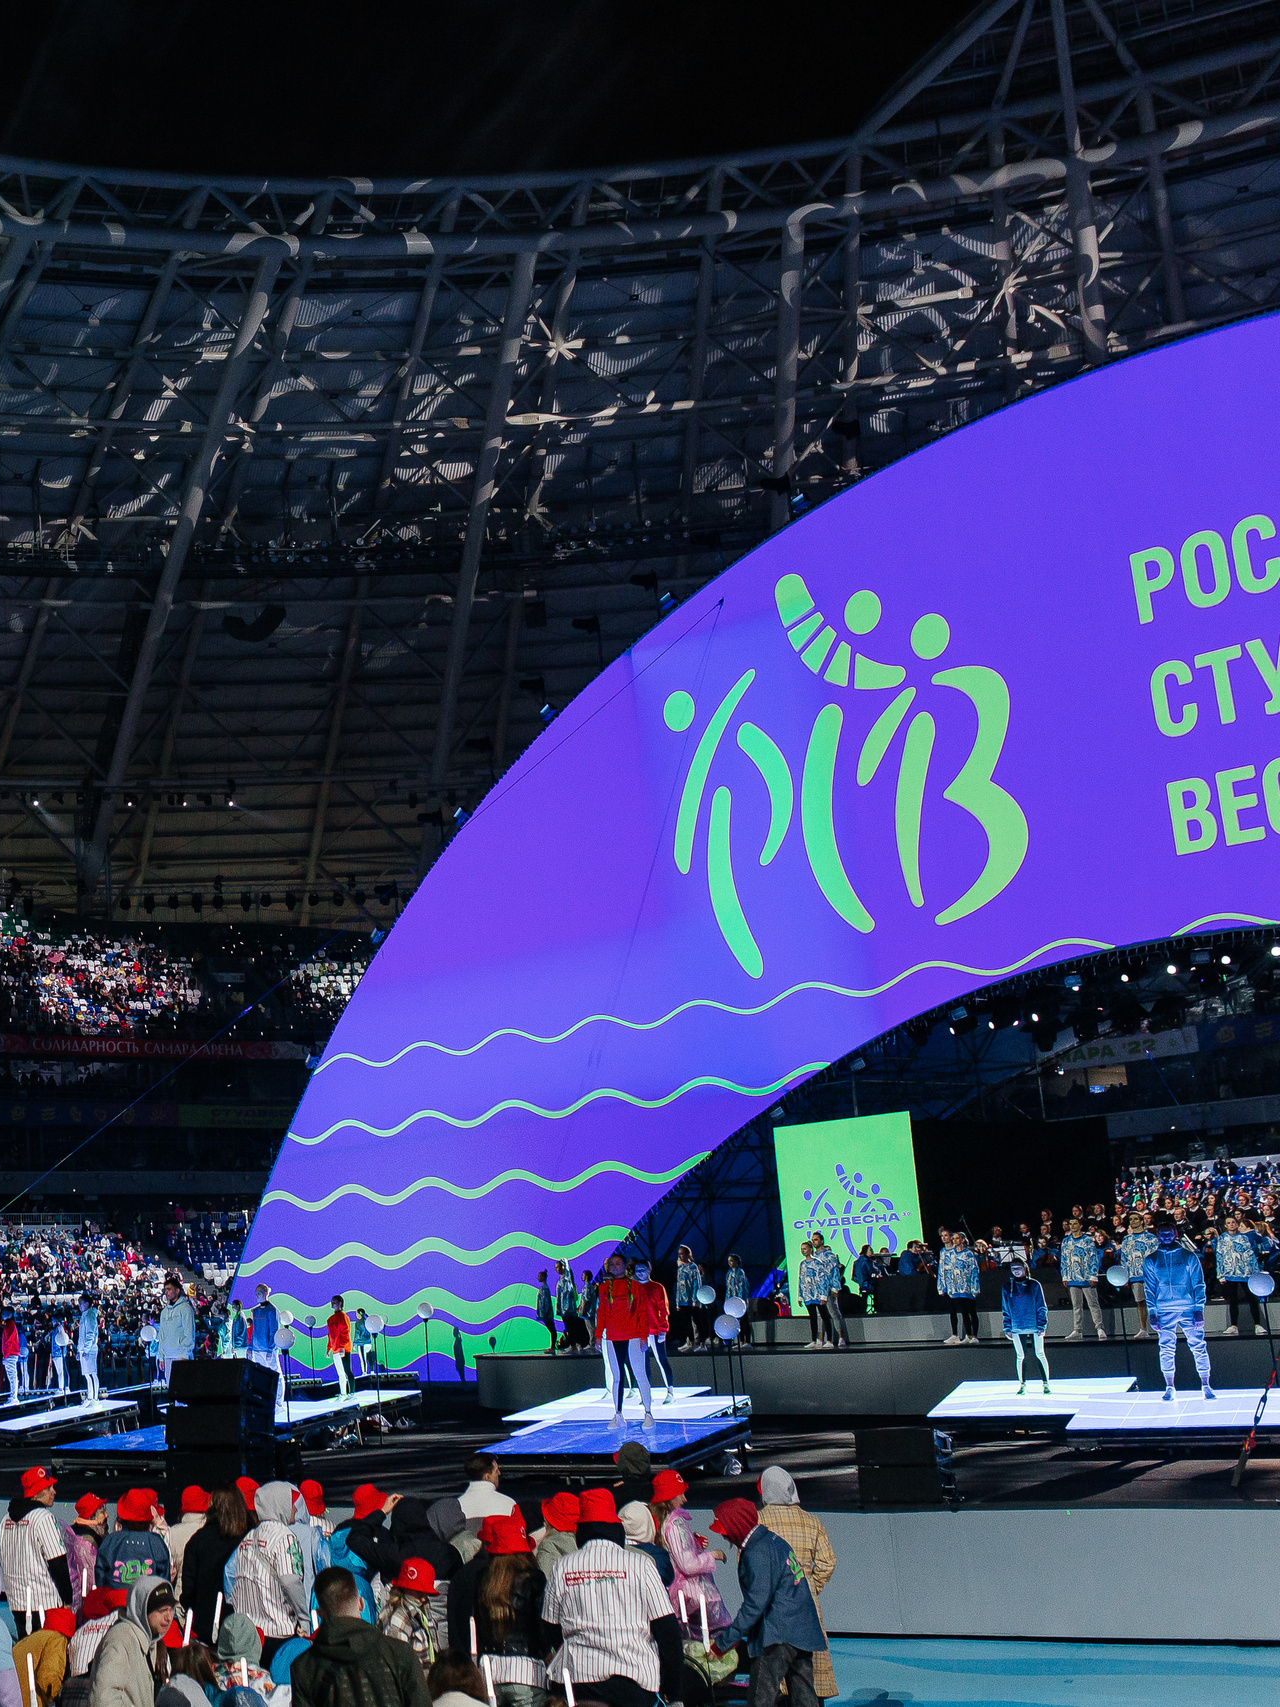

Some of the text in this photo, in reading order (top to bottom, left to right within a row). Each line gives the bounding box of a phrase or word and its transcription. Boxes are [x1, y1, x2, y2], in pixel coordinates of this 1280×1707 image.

[1128, 513, 1280, 626] РОС
[1149, 638, 1280, 738] СТУ
[32, 1037, 244, 1057] СОЛИДАРНОСТЬ САМАРА АРЕНА
[1055, 1043, 1116, 1063] МАРА
[793, 1212, 900, 1230] СТУДВЕСНА
